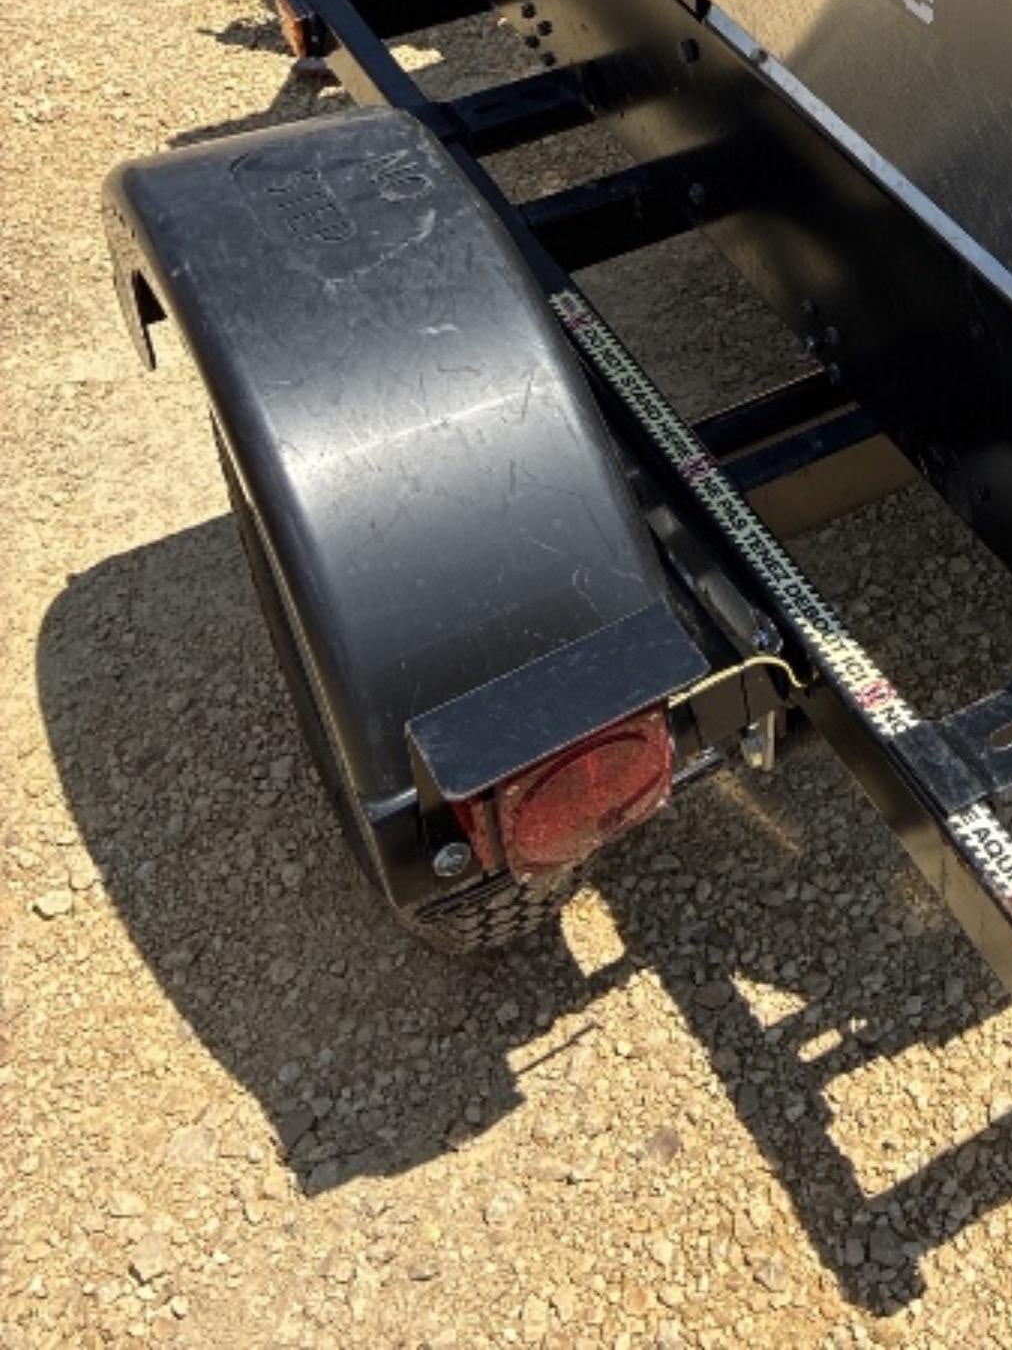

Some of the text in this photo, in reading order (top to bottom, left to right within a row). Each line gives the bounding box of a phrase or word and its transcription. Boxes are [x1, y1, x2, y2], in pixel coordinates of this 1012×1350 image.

[716, 499, 748, 531] PAS
[783, 583, 850, 652] DEBOUT
[840, 655, 867, 682] ICI
